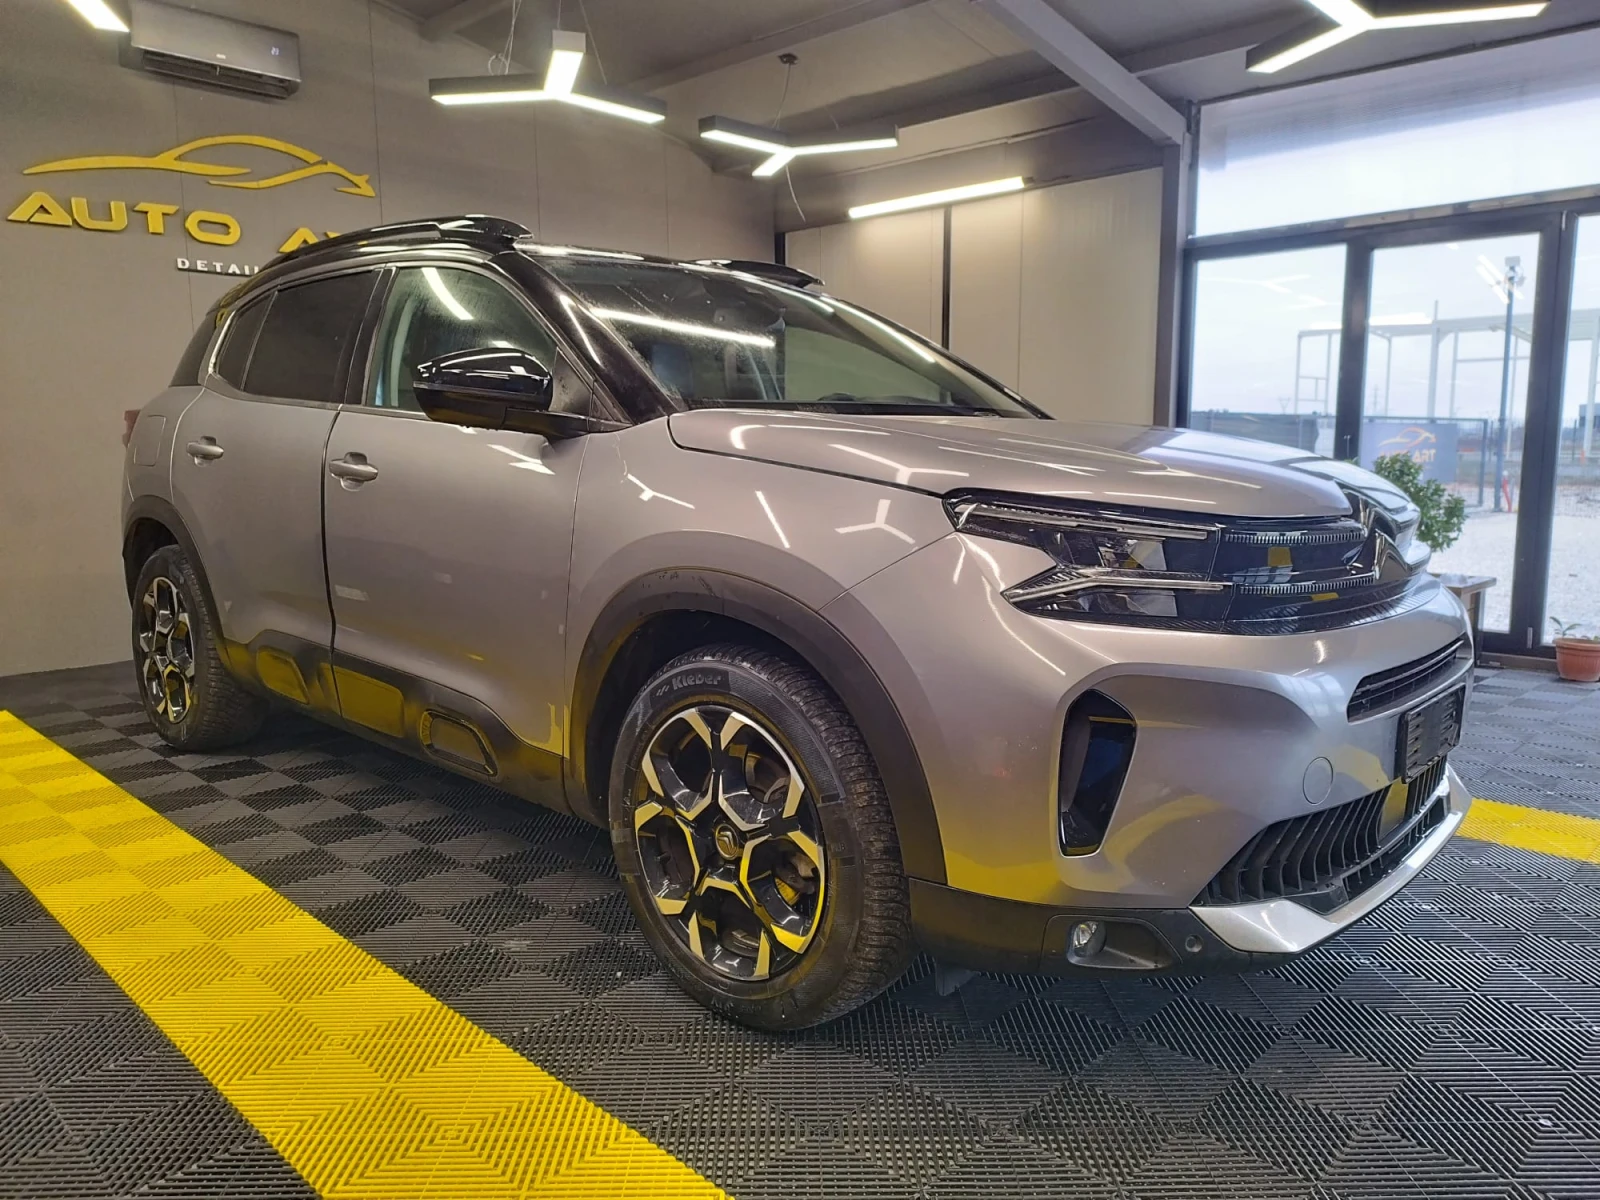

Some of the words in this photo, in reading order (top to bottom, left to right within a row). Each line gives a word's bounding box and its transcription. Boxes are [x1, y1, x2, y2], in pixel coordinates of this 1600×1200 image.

[7, 191, 241, 246] AUTO
[1412, 449, 1436, 463] ART
[672, 674, 722, 690] Kleber
